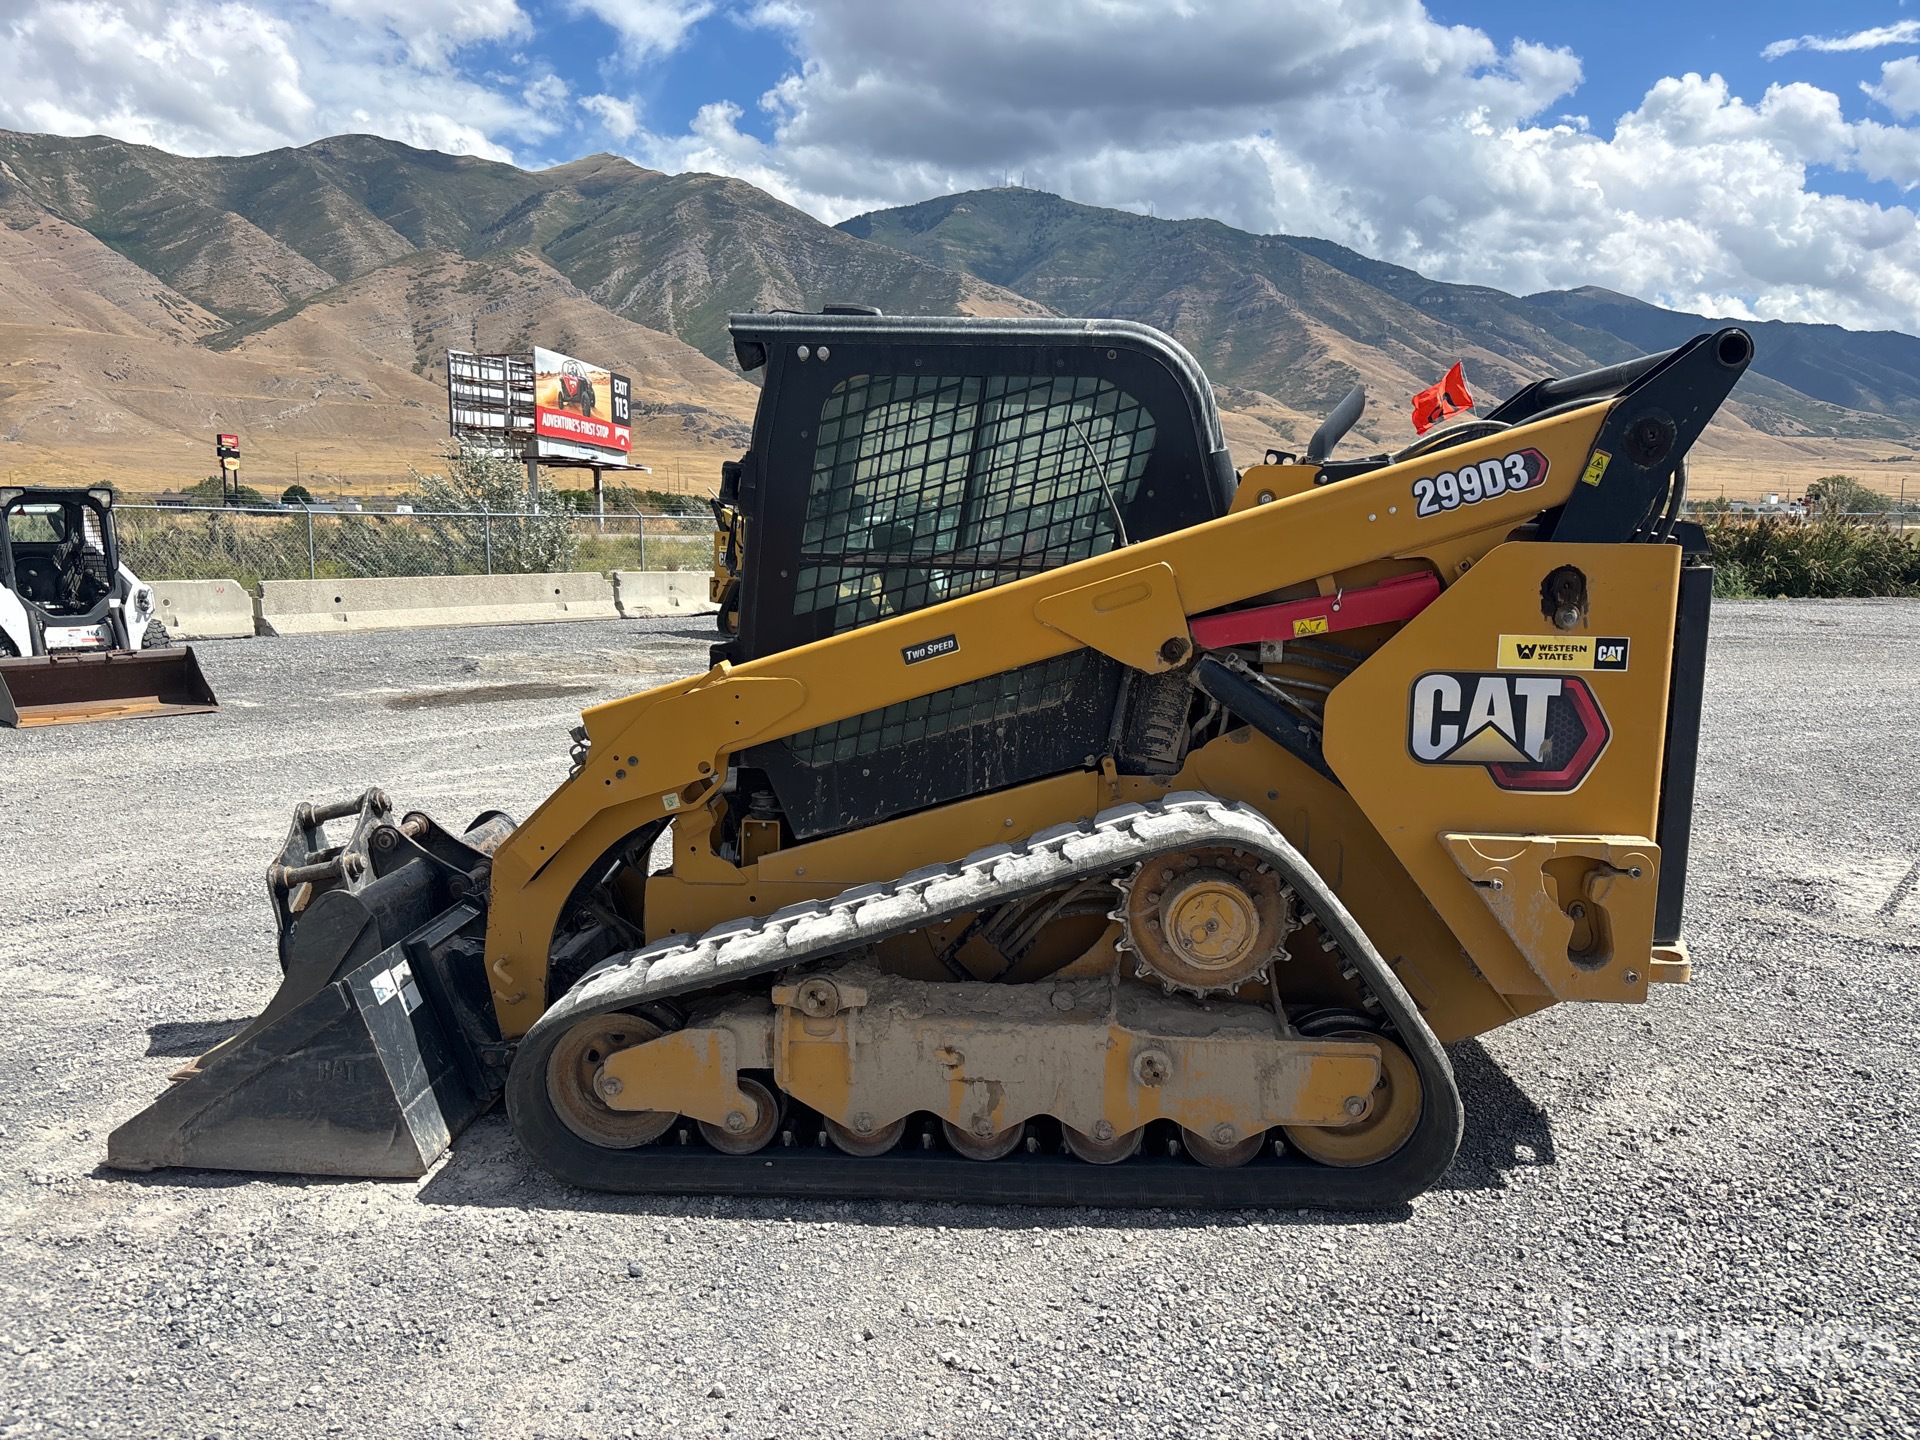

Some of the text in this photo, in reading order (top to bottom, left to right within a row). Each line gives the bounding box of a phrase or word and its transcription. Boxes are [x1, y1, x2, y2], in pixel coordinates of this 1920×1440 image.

[614, 379, 628, 396] EXIT
[615, 396, 629, 420] 113
[1412, 452, 1530, 517] 299D3
[1538, 643, 1587, 653] WESTERN
[1538, 652, 1574, 661] STATES
[1597, 645, 1625, 662] CAT
[1411, 674, 1562, 763] CAT
[317, 1060, 358, 1084] CAT
